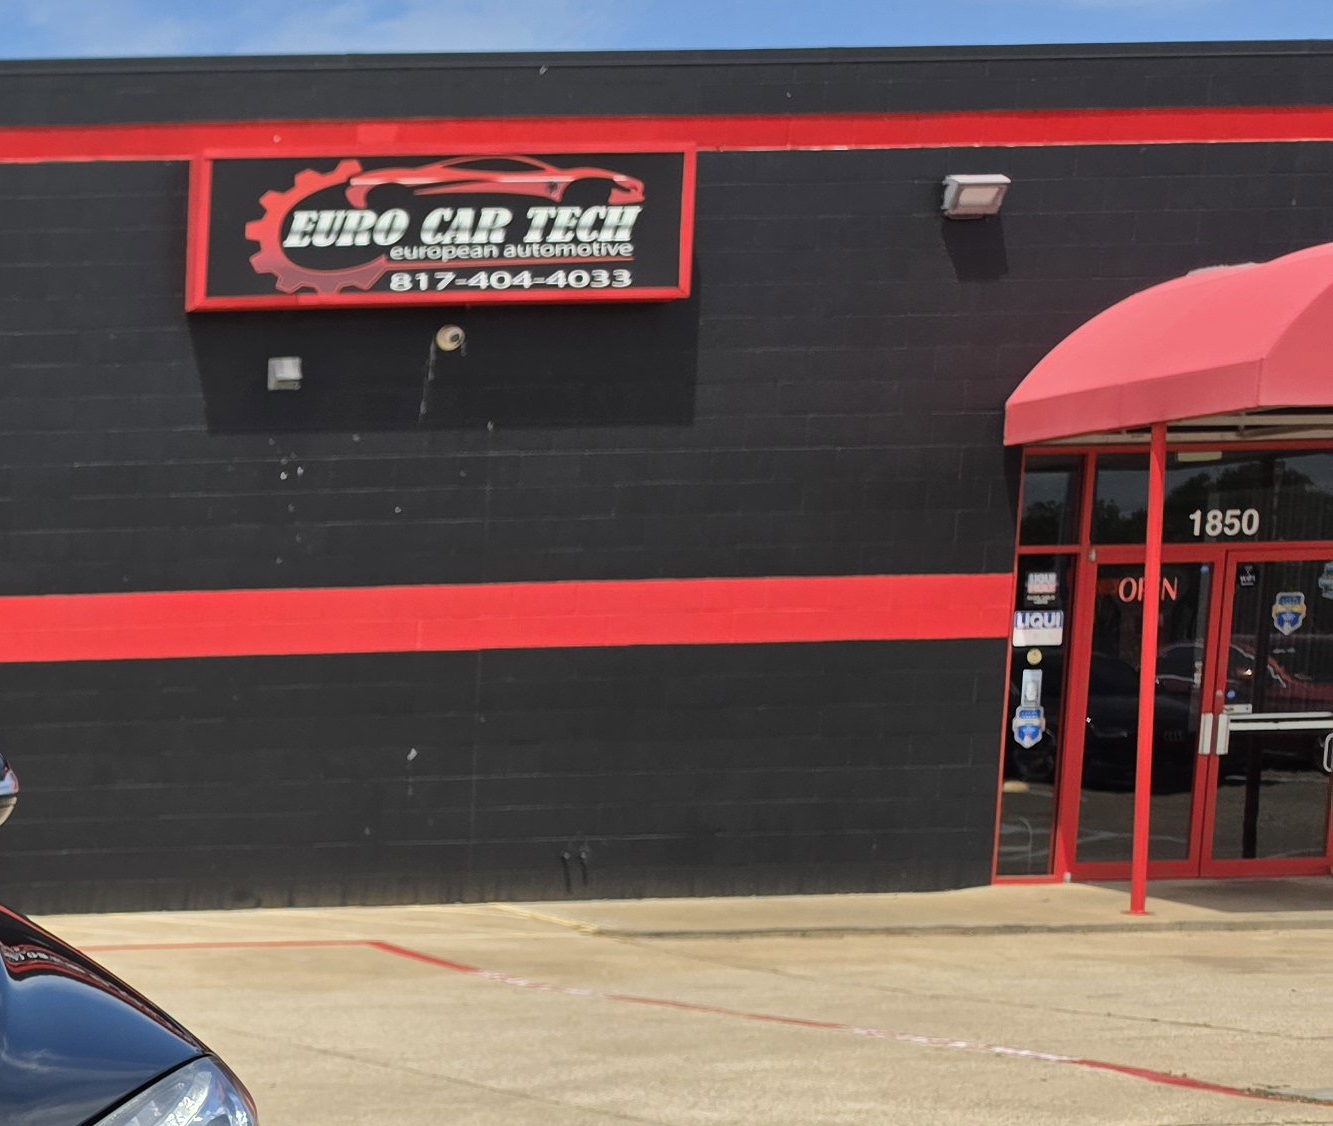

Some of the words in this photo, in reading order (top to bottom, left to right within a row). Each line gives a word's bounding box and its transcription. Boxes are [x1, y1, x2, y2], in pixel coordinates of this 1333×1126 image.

[283, 209, 410, 248] EURO
[420, 207, 513, 246] CAR
[526, 204, 644, 244] TECH
[390, 245, 499, 263] european
[503, 241, 634, 259] automotive
[390, 269, 632, 292] 817-404-4033
[1189, 508, 1260, 537] 1850
[1016, 611, 1061, 629] LIQUI
